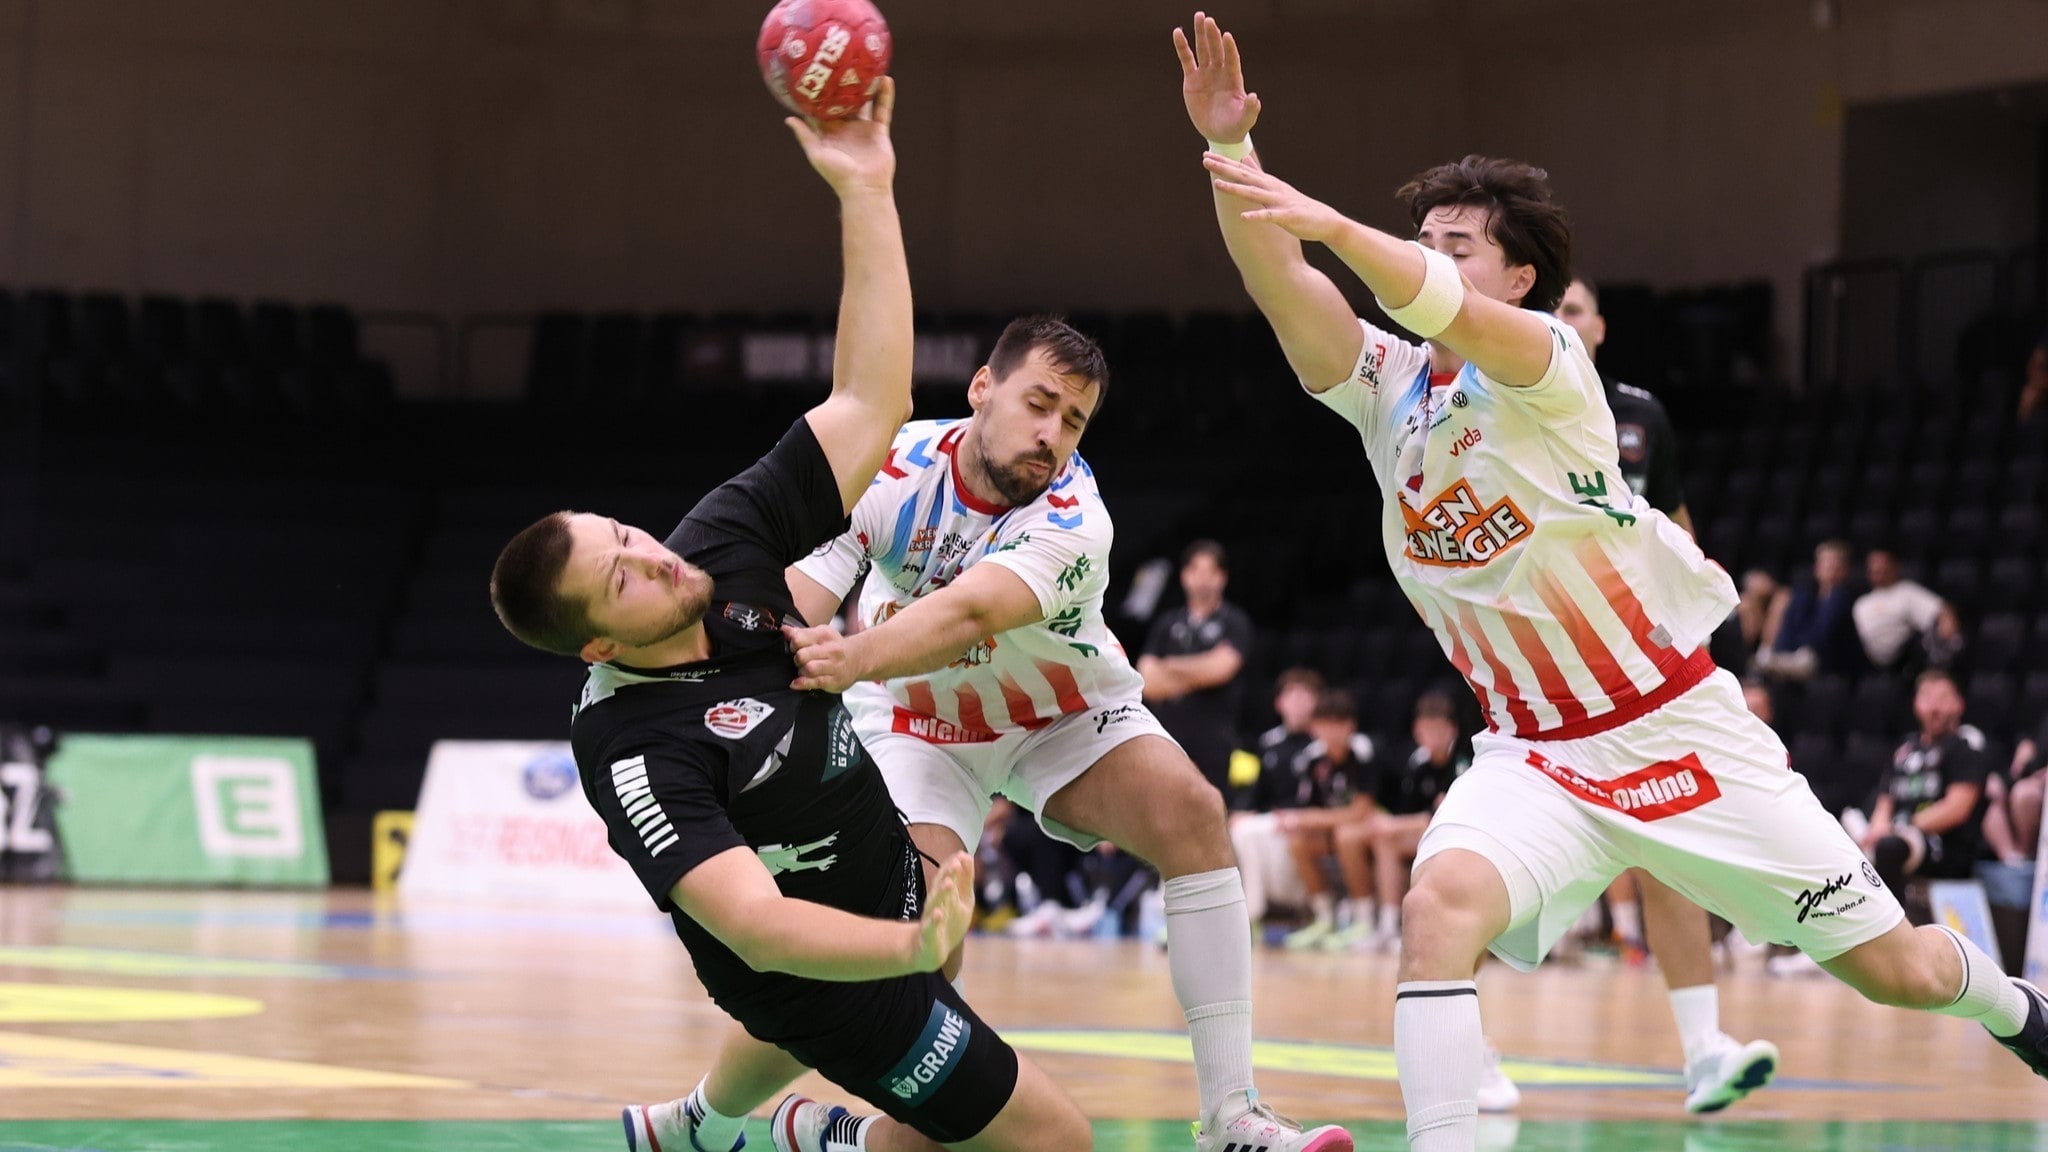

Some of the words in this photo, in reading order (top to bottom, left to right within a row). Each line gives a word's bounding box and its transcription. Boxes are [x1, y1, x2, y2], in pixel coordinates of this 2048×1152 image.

[1449, 427, 1482, 457] vida
[1810, 895, 1867, 919] www.john.at
[913, 1009, 964, 1084] GRAWE
